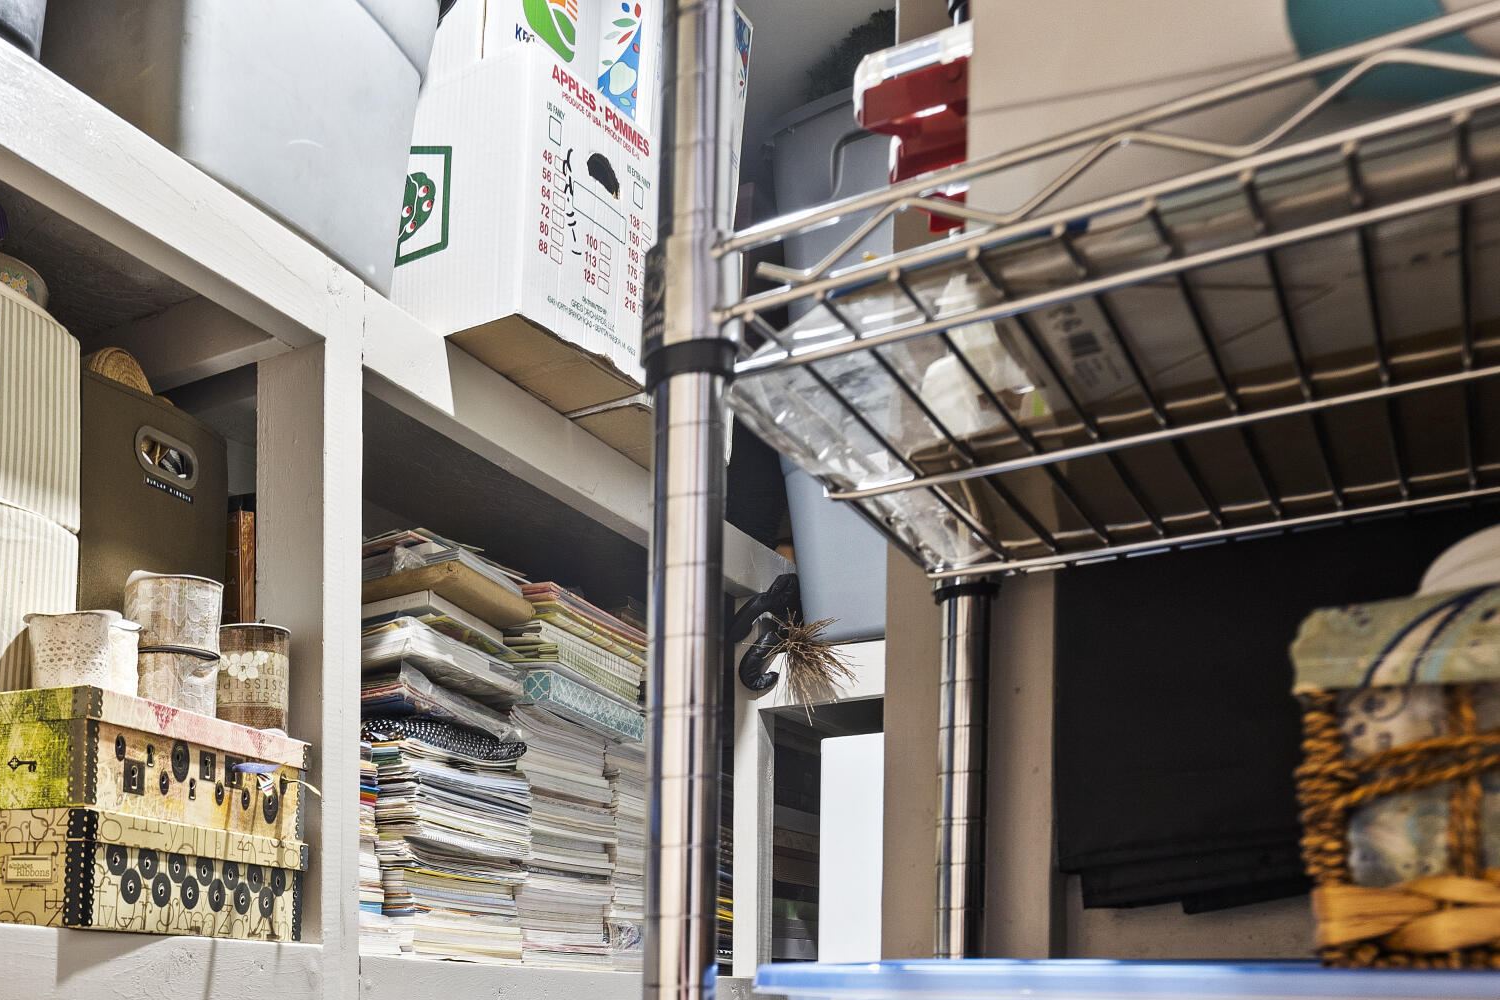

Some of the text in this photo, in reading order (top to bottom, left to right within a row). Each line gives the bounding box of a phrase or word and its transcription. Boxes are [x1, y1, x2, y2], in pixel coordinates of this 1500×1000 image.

[552, 64, 650, 157] APPLES POMMES
[562, 92, 585, 115] PRODUCE
[553, 105, 565, 120] FANCY
[543, 149, 553, 165] 48
[542, 167, 552, 183] 56
[541, 185, 551, 200] 64
[540, 203, 550, 219] 72
[539, 221, 549, 237] 80
[538, 239, 548, 255] 88
[586, 233, 598, 251] 100
[629, 231, 640, 247] 150
[585, 251, 597, 268] 113
[628, 247, 639, 264] 163
[584, 268, 596, 285] 125
[627, 264, 638, 280] 175
[624, 296, 636, 313] 216
[16, 868, 51, 877] Ribbons
